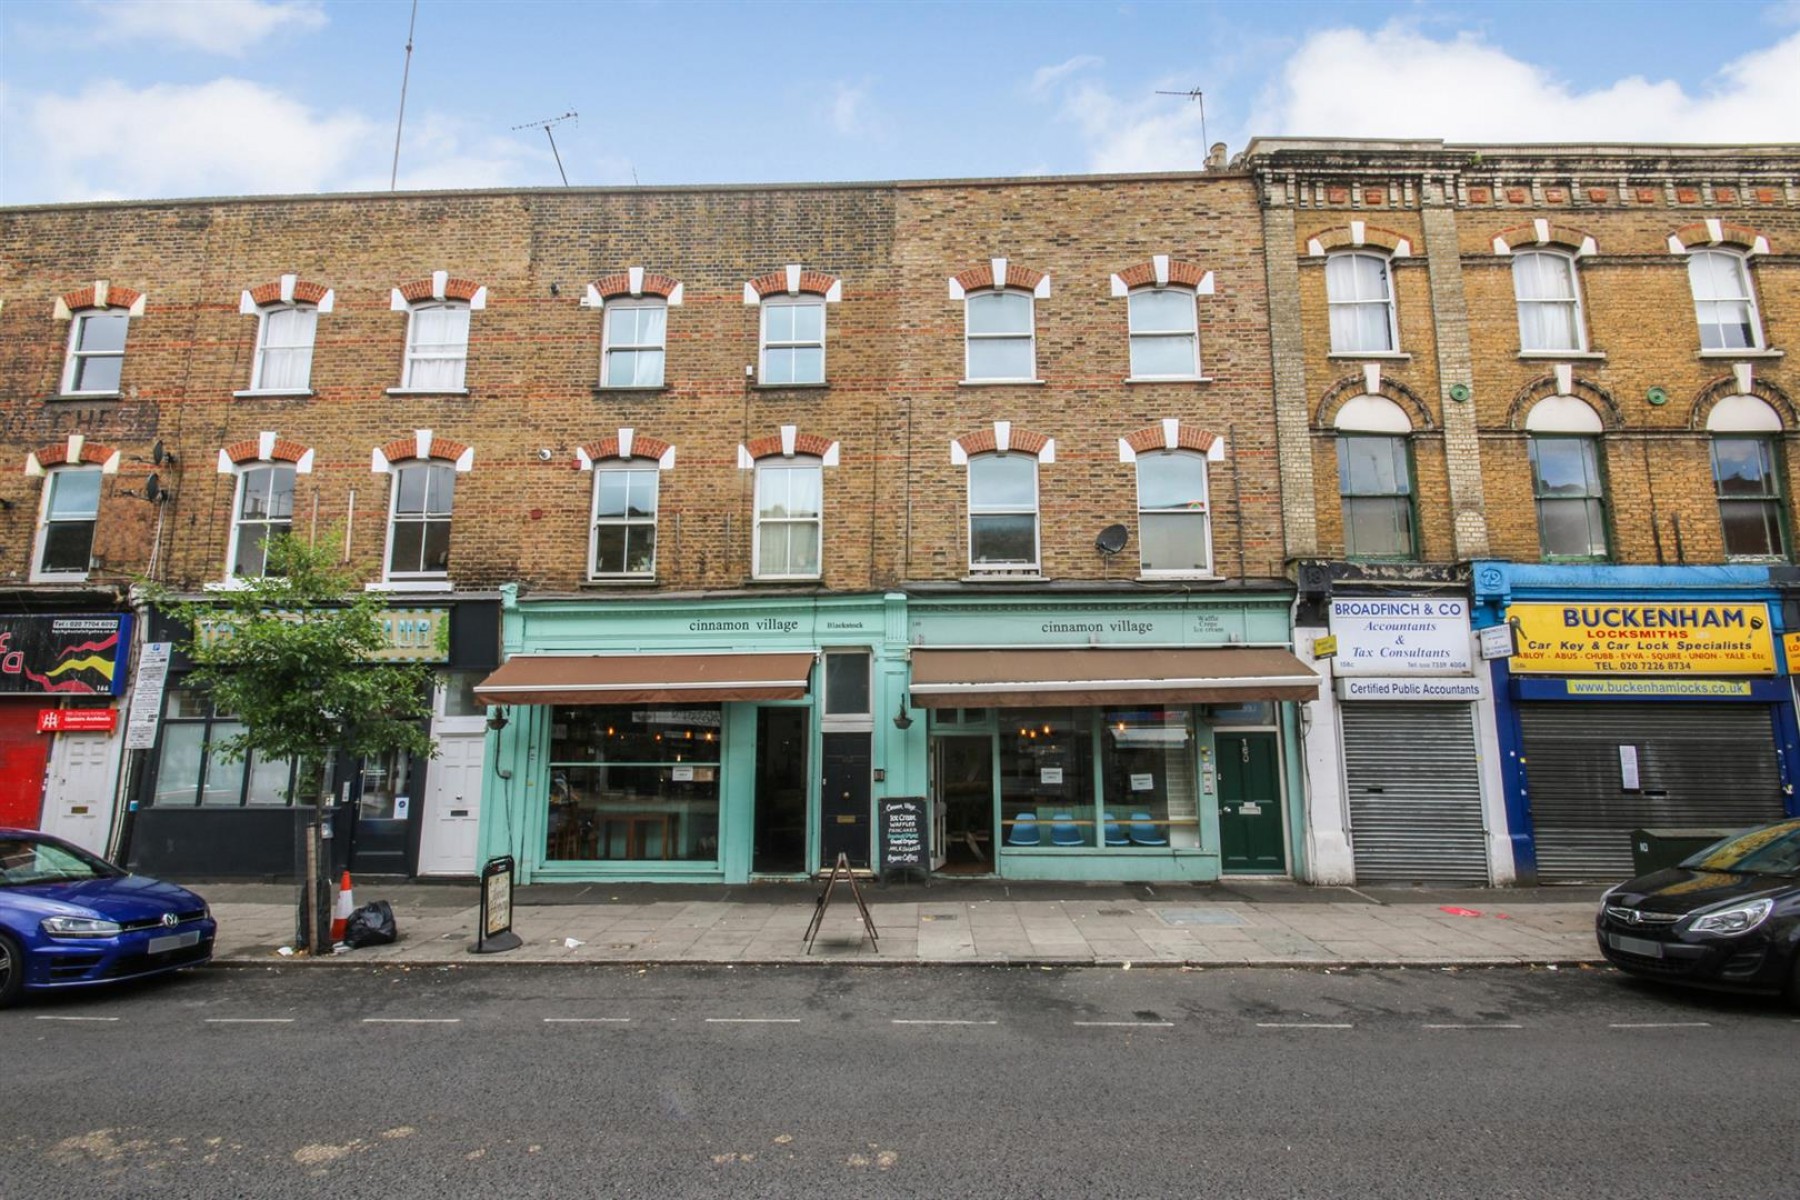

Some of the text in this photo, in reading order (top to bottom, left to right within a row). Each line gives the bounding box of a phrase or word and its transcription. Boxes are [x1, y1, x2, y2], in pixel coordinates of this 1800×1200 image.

[1335, 603, 1461, 616] BROADFINCH & CO
[1563, 608, 1745, 628] BUCKENHAM
[689, 619, 798, 633] cinnamon village
[827, 621, 863, 629] Blackstock
[1041, 620, 1153, 635] cinnamon village
[1364, 621, 1437, 631] Accountants
[1587, 630, 1688, 639] LOCKSMITHS
[1395, 635, 1405, 645] &
[1528, 641, 1752, 651] Car Key & Car Lock Specialists
[1353, 647, 1451, 657] Tax Consultants
[1517, 652, 1545, 660] ABLOY
[1555, 652, 1578, 660] ABUS
[1585, 652, 1614, 660] CHUBB
[1621, 652, 1644, 660] EVVA
[1651, 652, 1681, 660] SQUIRE
[1689, 652, 1717, 660] UNION
[1725, 652, 1745, 660] YALE
[1595, 662, 1691, 671] TEL. 020 7226 8734
[1351, 683, 1480, 695] Certified Public Accountants
[1574, 682, 1744, 694] www.buckenhamlocks.co.uk
